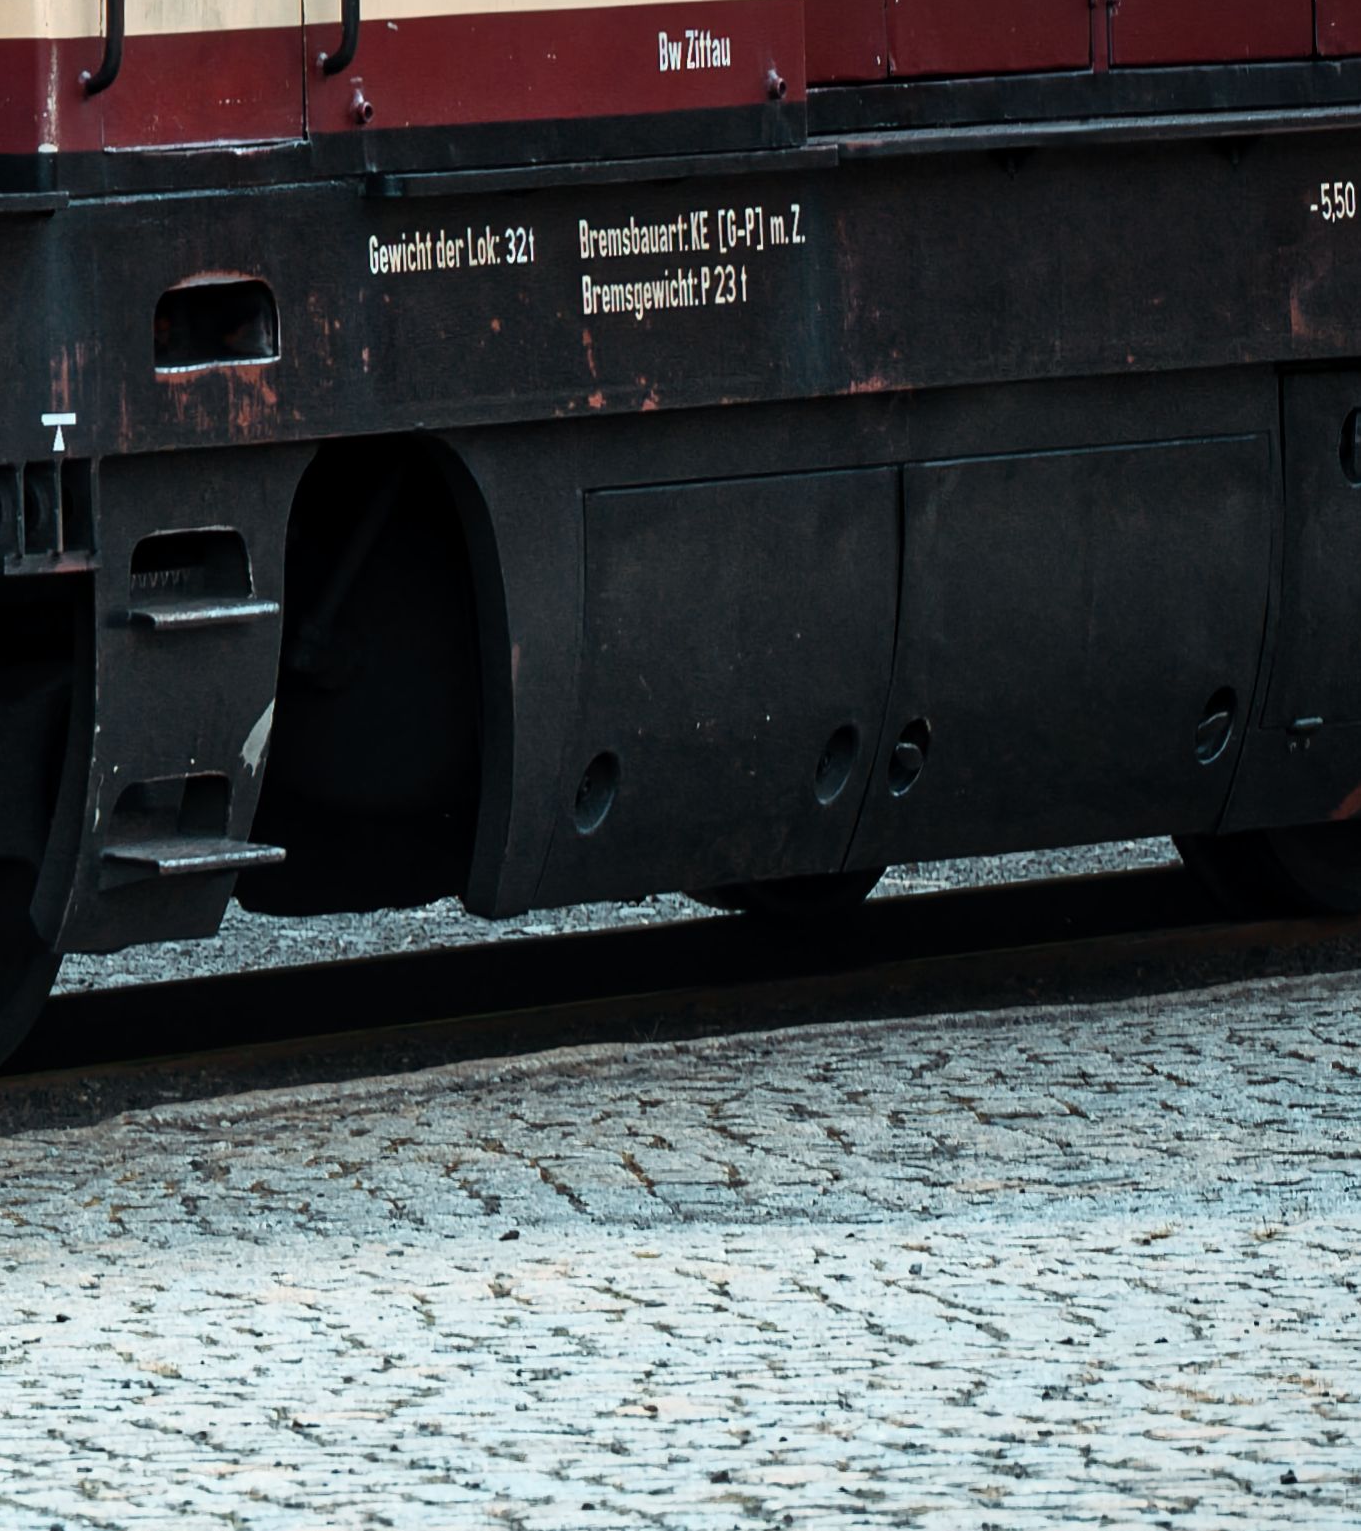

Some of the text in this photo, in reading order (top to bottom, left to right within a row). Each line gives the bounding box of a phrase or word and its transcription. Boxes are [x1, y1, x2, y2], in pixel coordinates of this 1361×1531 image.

[658, 29, 731, 72] Bw Zittau
[368, 230, 433, 274] Gewicht
[436, 229, 465, 269] der
[467, 225, 501, 267] Lok:
[579, 214, 688, 260] Bremsbauart:
[690, 210, 710, 251] KE
[718, 206, 764, 254] [G-P]
[581, 264, 748, 321] Bremsgewicht: P 23 t
